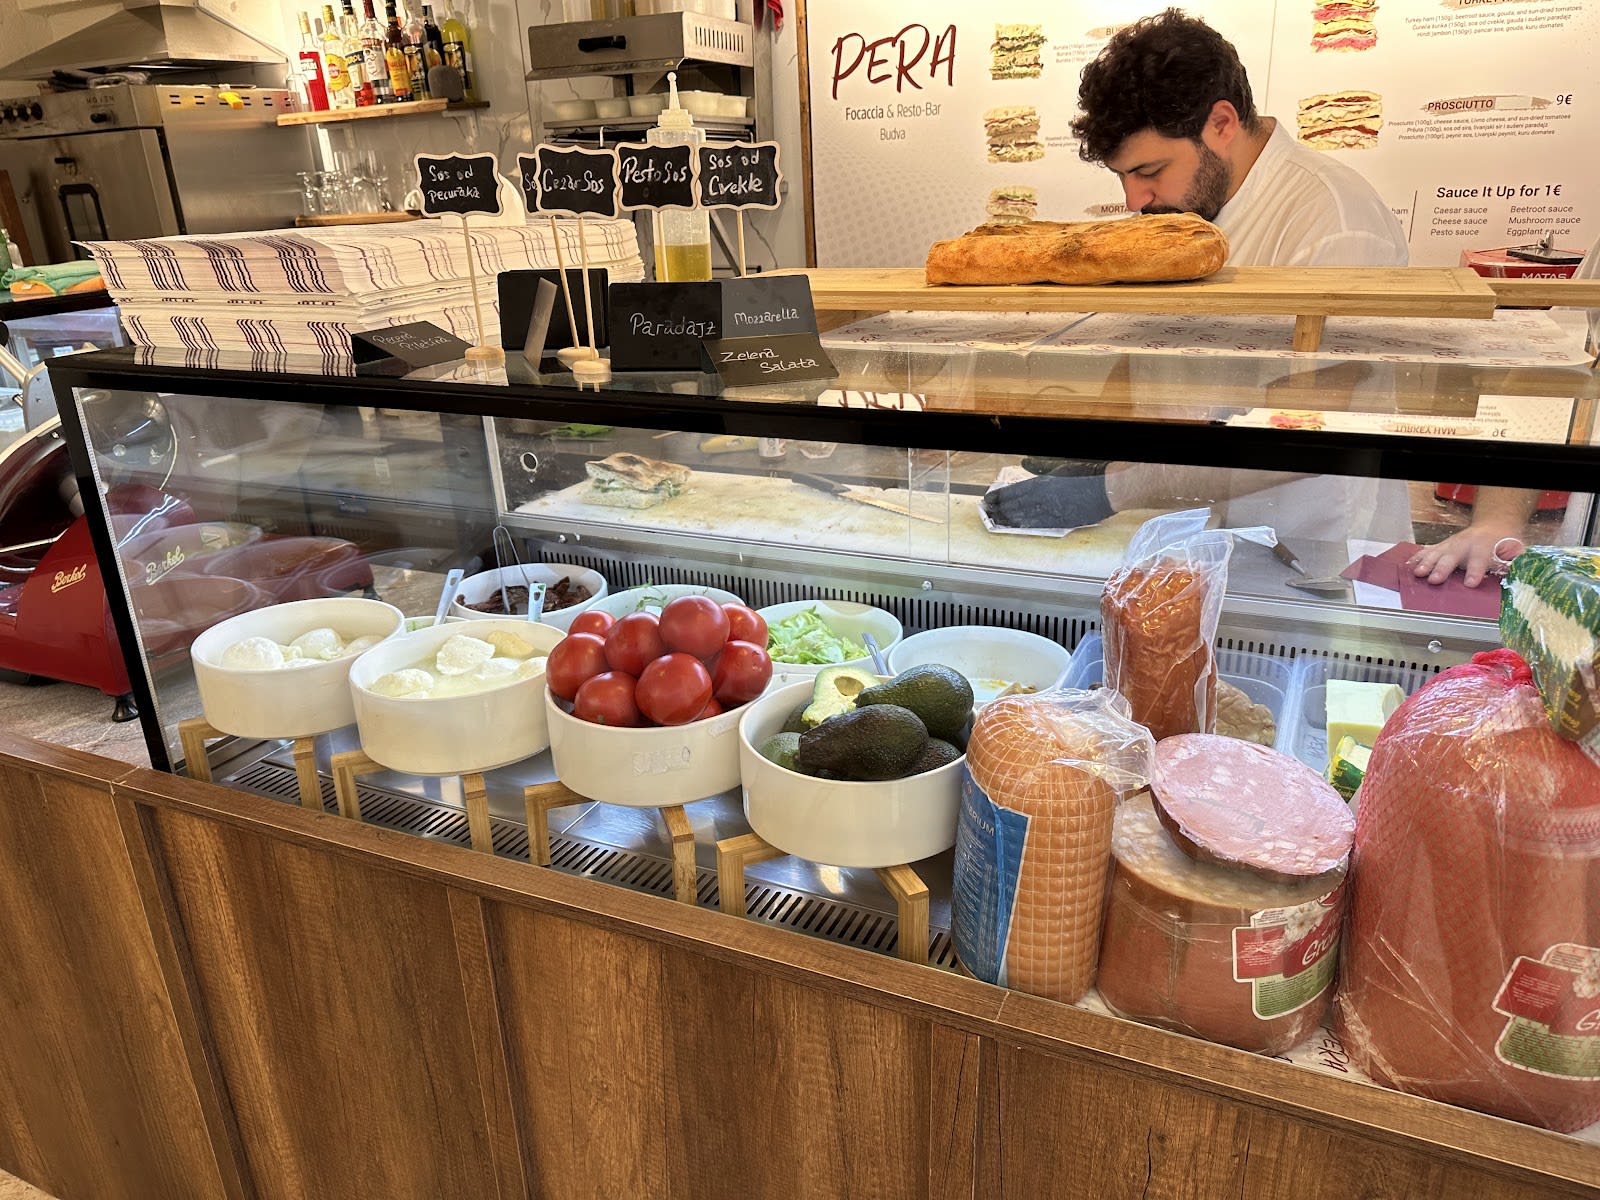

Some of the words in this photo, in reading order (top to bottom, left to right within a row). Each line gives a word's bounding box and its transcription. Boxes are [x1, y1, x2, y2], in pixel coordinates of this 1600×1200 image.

[831, 24, 957, 100] PERA
[845, 105, 884, 120] Focaccia
[886, 104, 894, 118] &
[896, 102, 942, 118] Resto-Bar
[1428, 99, 1493, 111] PROSCIUTTO
[1556, 94, 1573, 106] 9€
[880, 128, 906, 141] Budva
[709, 154, 732, 171] Sos
[740, 150, 760, 166] od
[428, 164, 450, 182] Sos
[457, 164, 474, 181] od
[622, 156, 662, 184] Pesto
[663, 162, 688, 184] Sos
[524, 172, 537, 192] So
[542, 168, 582, 192] Cezar
[582, 170, 604, 194] Sos
[1436, 186, 1478, 198] Sauce
[1482, 186, 1492, 197] It
[1496, 186, 1515, 200] Up
[1520, 184, 1540, 197] for
[1544, 184, 1562, 197] 1€
[1433, 206, 1462, 214] Caesar
[1510, 205, 1546, 213] Beetroot
[1506, 228, 1543, 237] Eggplant
[734, 307, 800, 326] Mozzarella
[720, 348, 780, 362] Zelena
[760, 358, 820, 374] Salata
[51, 564, 87, 593] Berkel
